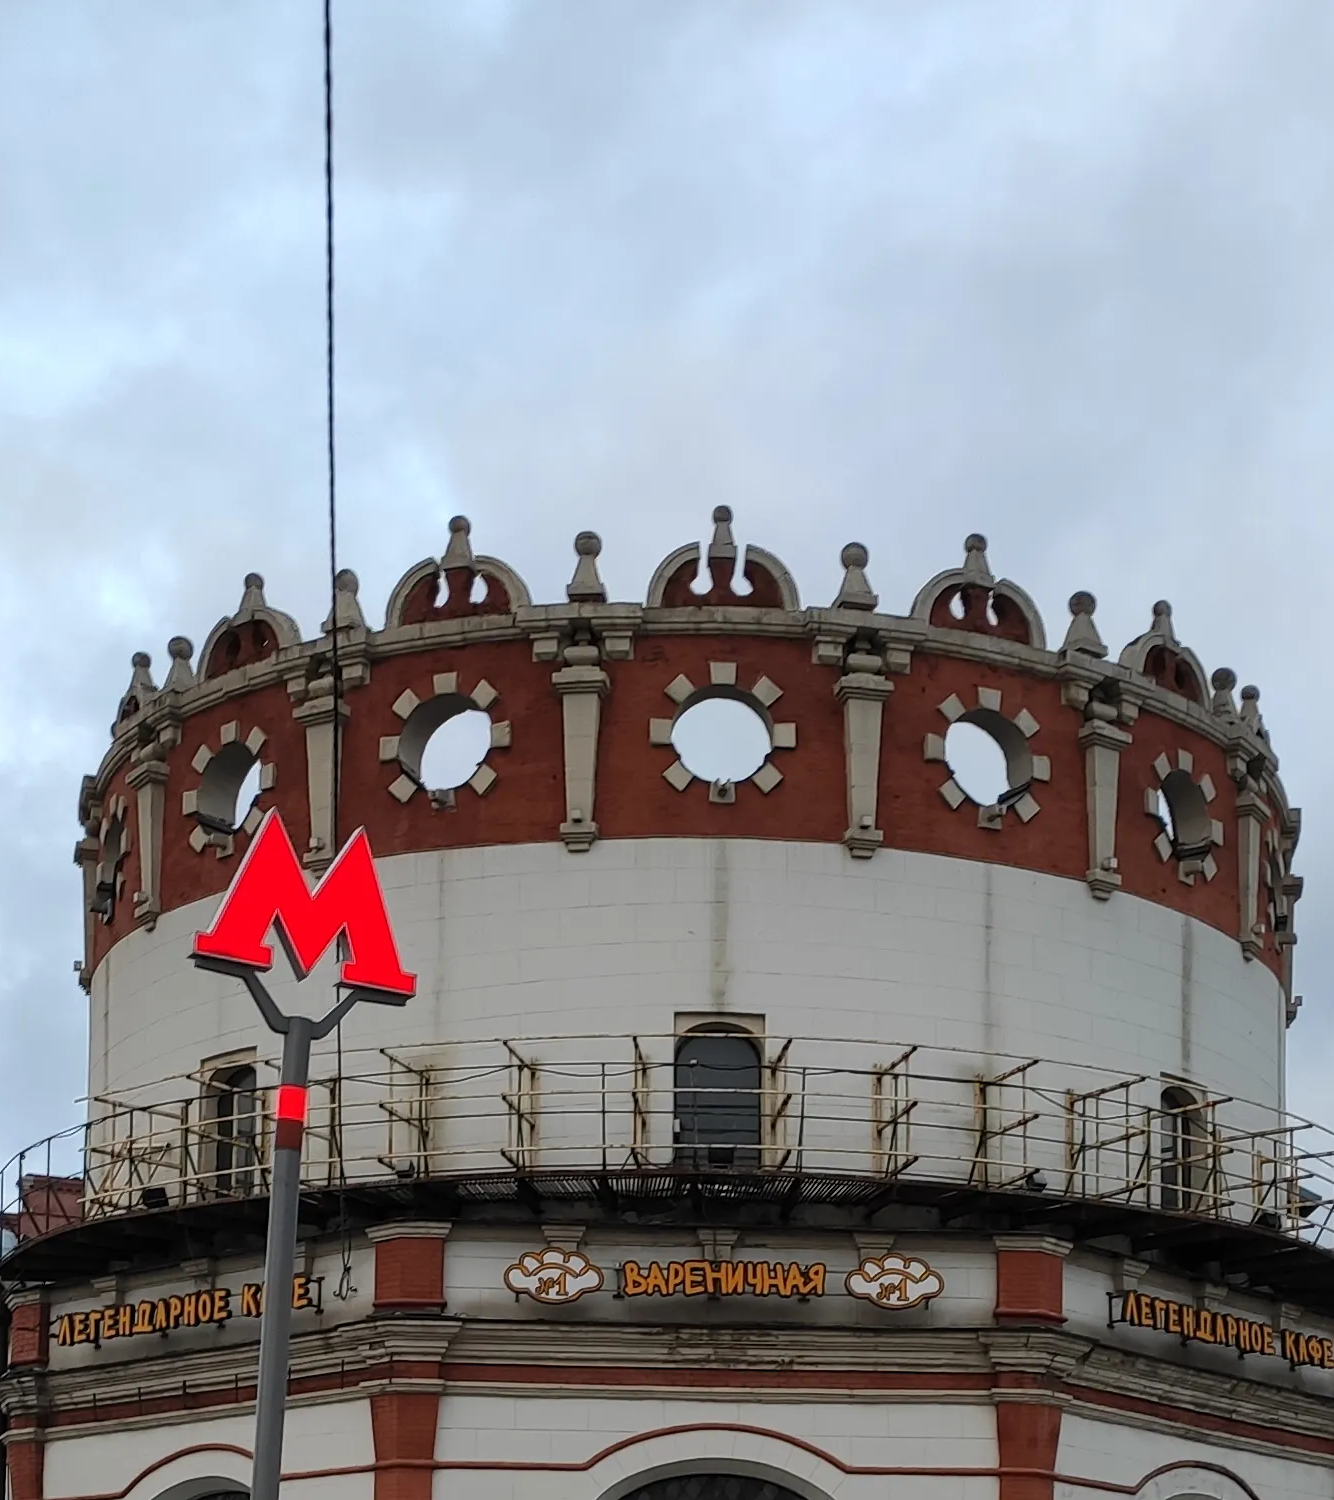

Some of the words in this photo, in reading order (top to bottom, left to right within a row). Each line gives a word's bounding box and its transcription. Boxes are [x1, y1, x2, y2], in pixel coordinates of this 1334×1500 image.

[57, 1288, 232, 1347] ЛЕГЕНДАРНОЕ
[240, 1273, 310, 1319] КЕ
[622, 1259, 828, 1298] ВАРЕНИЧНАЯ
[1123, 1289, 1276, 1357] ЛЕГЕНДАРНОЕ
